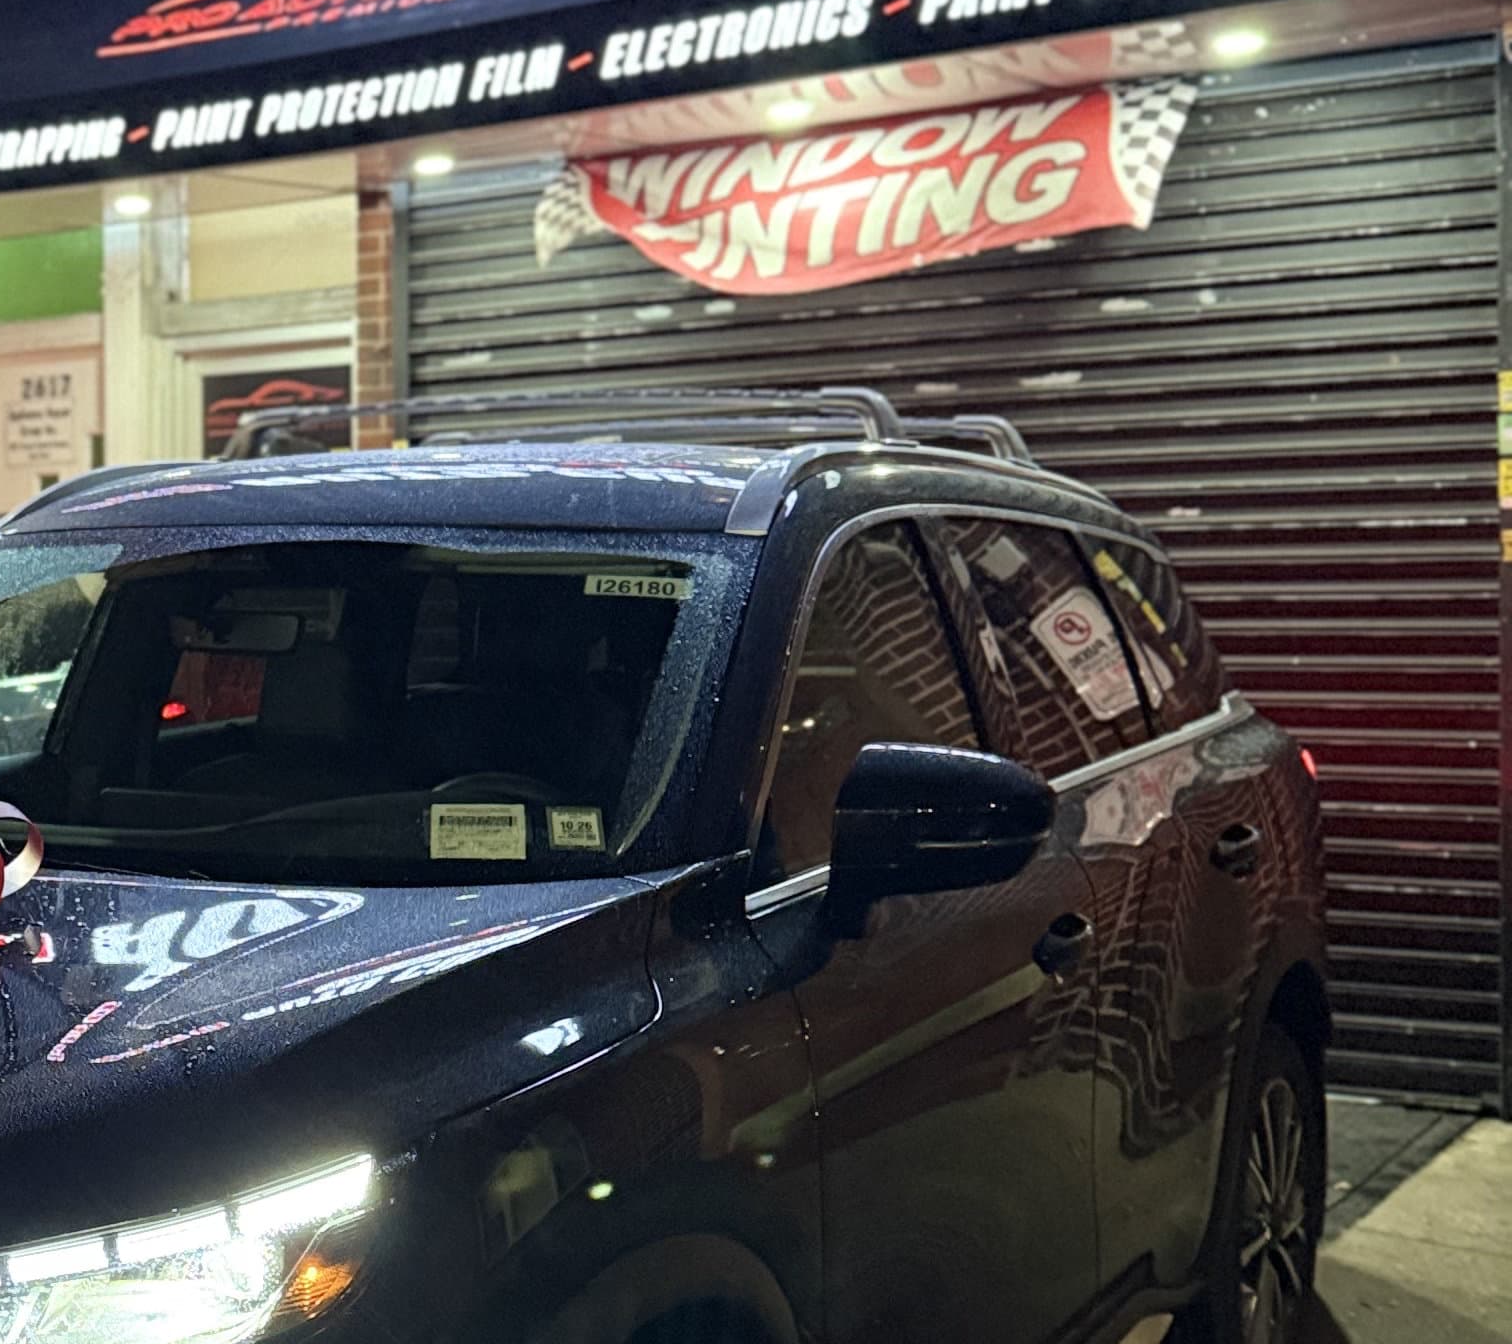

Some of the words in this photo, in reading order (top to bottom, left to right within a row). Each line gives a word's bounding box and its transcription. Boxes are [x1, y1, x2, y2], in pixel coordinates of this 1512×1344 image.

[151, 97, 253, 152] PAINT
[254, 61, 465, 138] PROTECTION
[468, 43, 566, 104] FILM
[608, 95, 1084, 220] WINDOW
